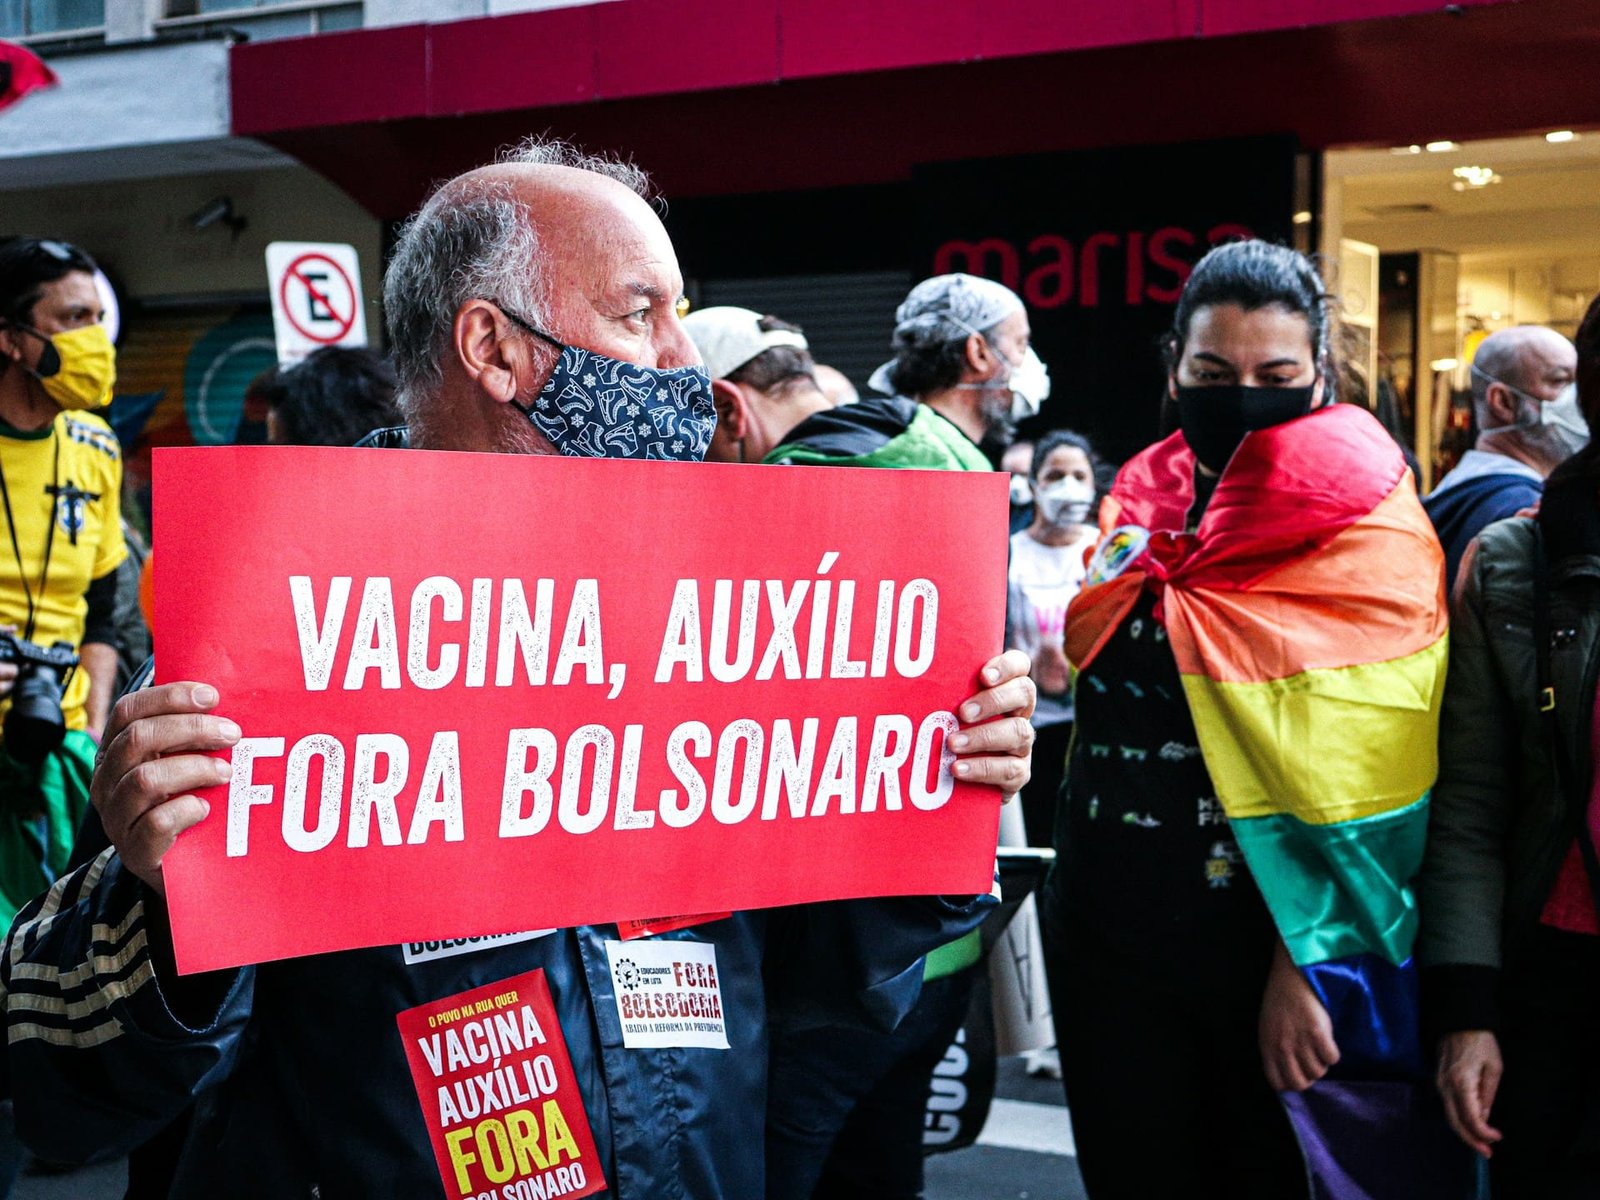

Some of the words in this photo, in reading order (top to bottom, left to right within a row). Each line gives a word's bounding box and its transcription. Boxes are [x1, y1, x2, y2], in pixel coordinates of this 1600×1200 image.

[304, 273, 338, 321] E
[933, 223, 1254, 309] maris
[288, 575, 627, 700] VACINA,
[653, 551, 939, 683] AUXÍLIO
[225, 730, 465, 858] FORA
[498, 710, 961, 838] BOLSONARO
[428, 1016, 436, 1028] O
[437, 1009, 460, 1026] POVO
[461, 1004, 475, 1018] NA
[475, 998, 494, 1014] RUA
[495, 991, 519, 1009] QUER
[651, 977, 662, 985] LUTA
[672, 962, 717, 988] FORA
[418, 1005, 547, 1077] VACINA
[625, 1023, 648, 1034] ABAIXO
[649, 1023, 655, 1033] A
[655, 1022, 684, 1033] REFORMA
[685, 1022, 693, 1033] DA
[437, 1054, 558, 1127] AUXÍLIO
[445, 1099, 581, 1195] FORA
